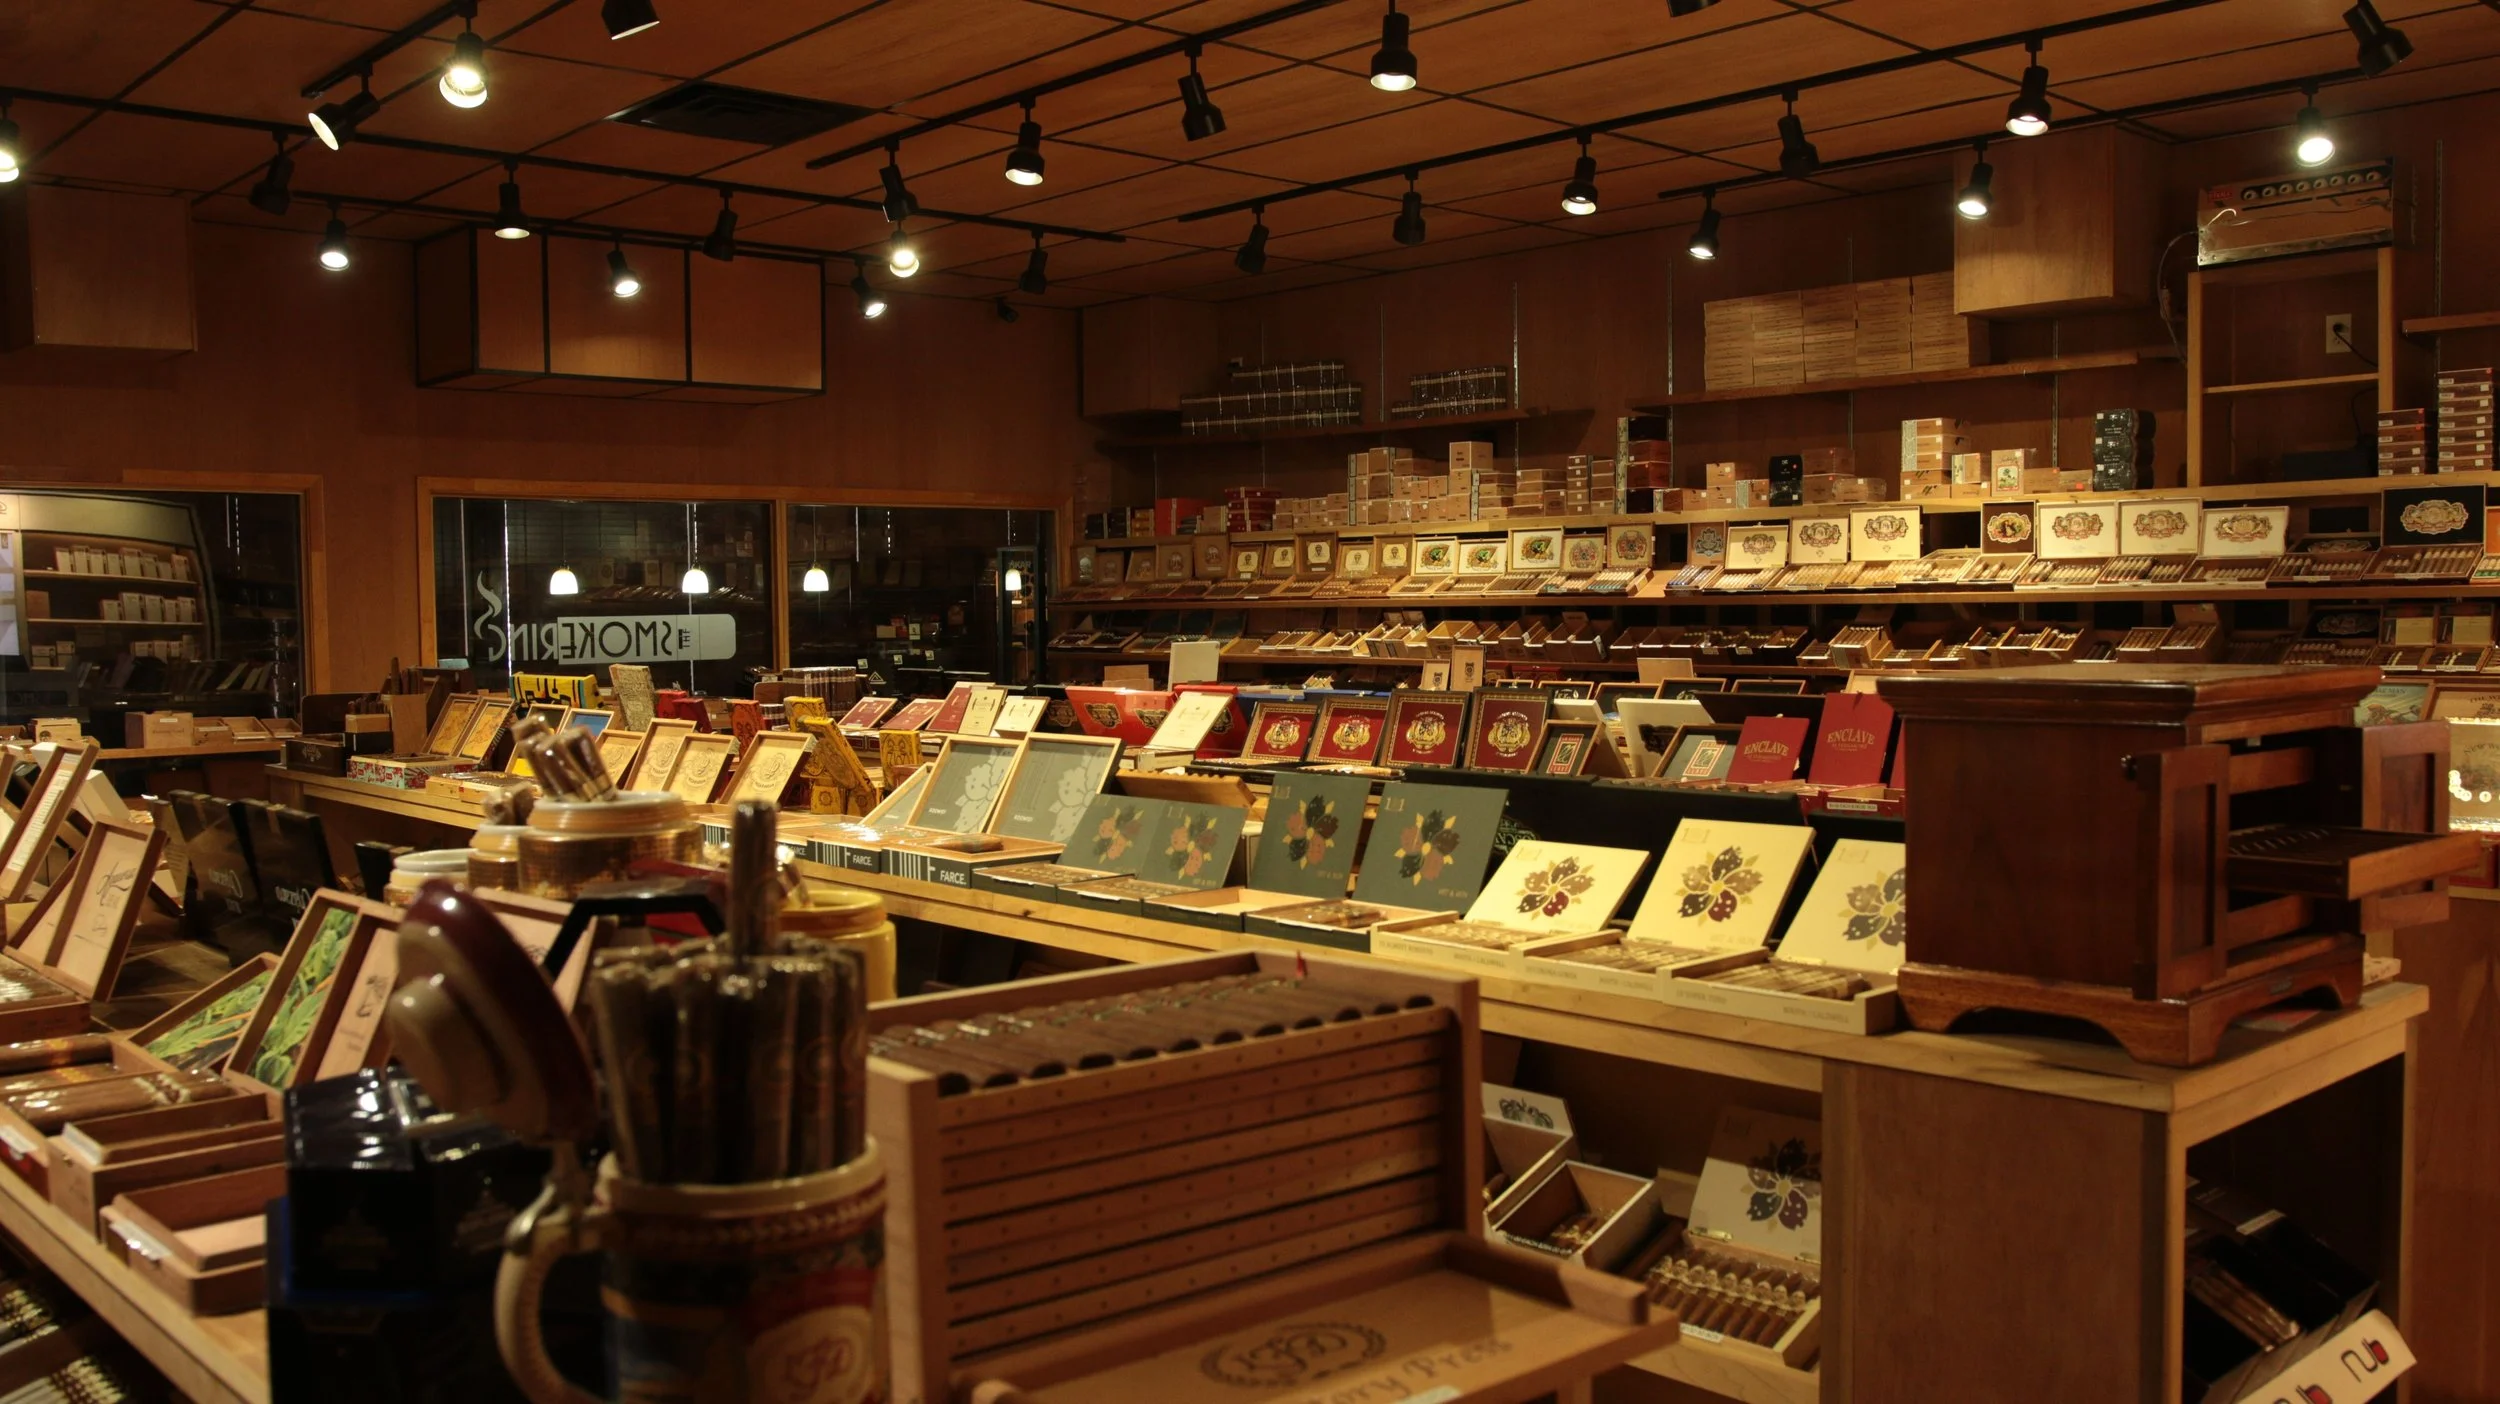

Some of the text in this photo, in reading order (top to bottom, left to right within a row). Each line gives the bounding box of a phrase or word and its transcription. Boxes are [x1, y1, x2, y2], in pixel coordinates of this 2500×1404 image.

[1827, 728, 1876, 745] ENCLAVE
[1743, 740, 1789, 757] ENCLAVE
[939, 870, 967, 886] FARCE.
